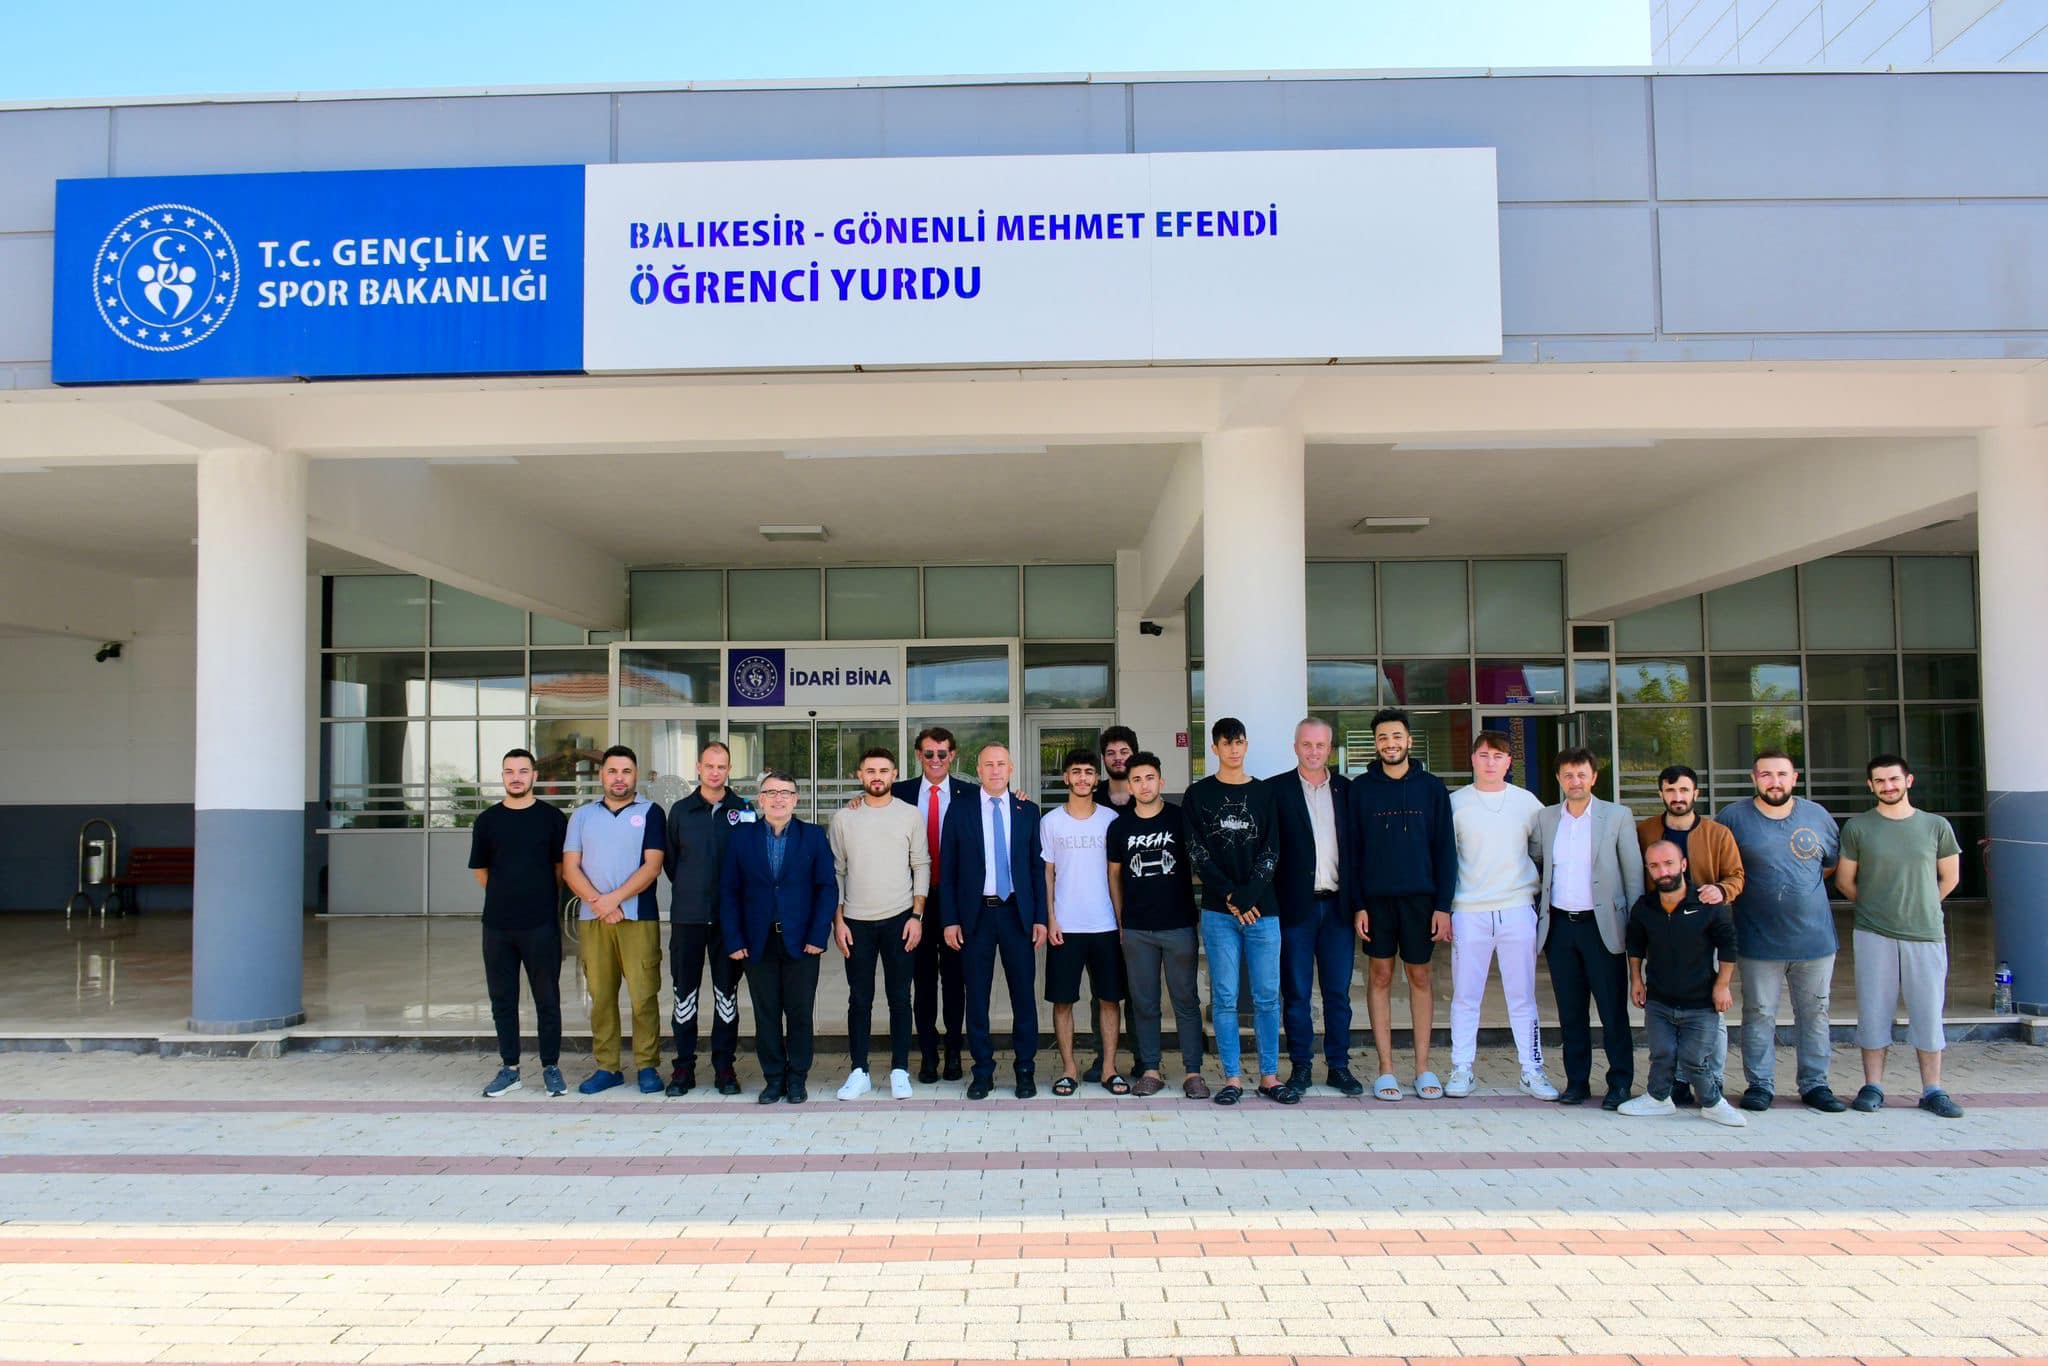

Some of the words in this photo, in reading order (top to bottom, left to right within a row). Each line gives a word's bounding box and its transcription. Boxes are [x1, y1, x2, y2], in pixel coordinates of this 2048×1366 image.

[630, 213, 805, 249] BALIKESİR
[833, 208, 986, 246] GÖNENLİ
[996, 212, 1146, 242] MEHMET
[1155, 203, 1278, 238] EFENDİ
[258, 239, 321, 268] T.C.
[332, 230, 490, 272] GENÇLİK
[502, 234, 547, 261] VE
[258, 279, 348, 308] SPOR
[359, 269, 547, 306] BAKANLIĞI
[630, 260, 819, 305] ÖĞRENCİ
[830, 266, 981, 302] YURDU
[789, 667, 840, 687] İDARİ
[845, 666, 892, 686] BİNA
[1055, 835, 1107, 849] RELEAS
[1127, 830, 1176, 851] BREAK
